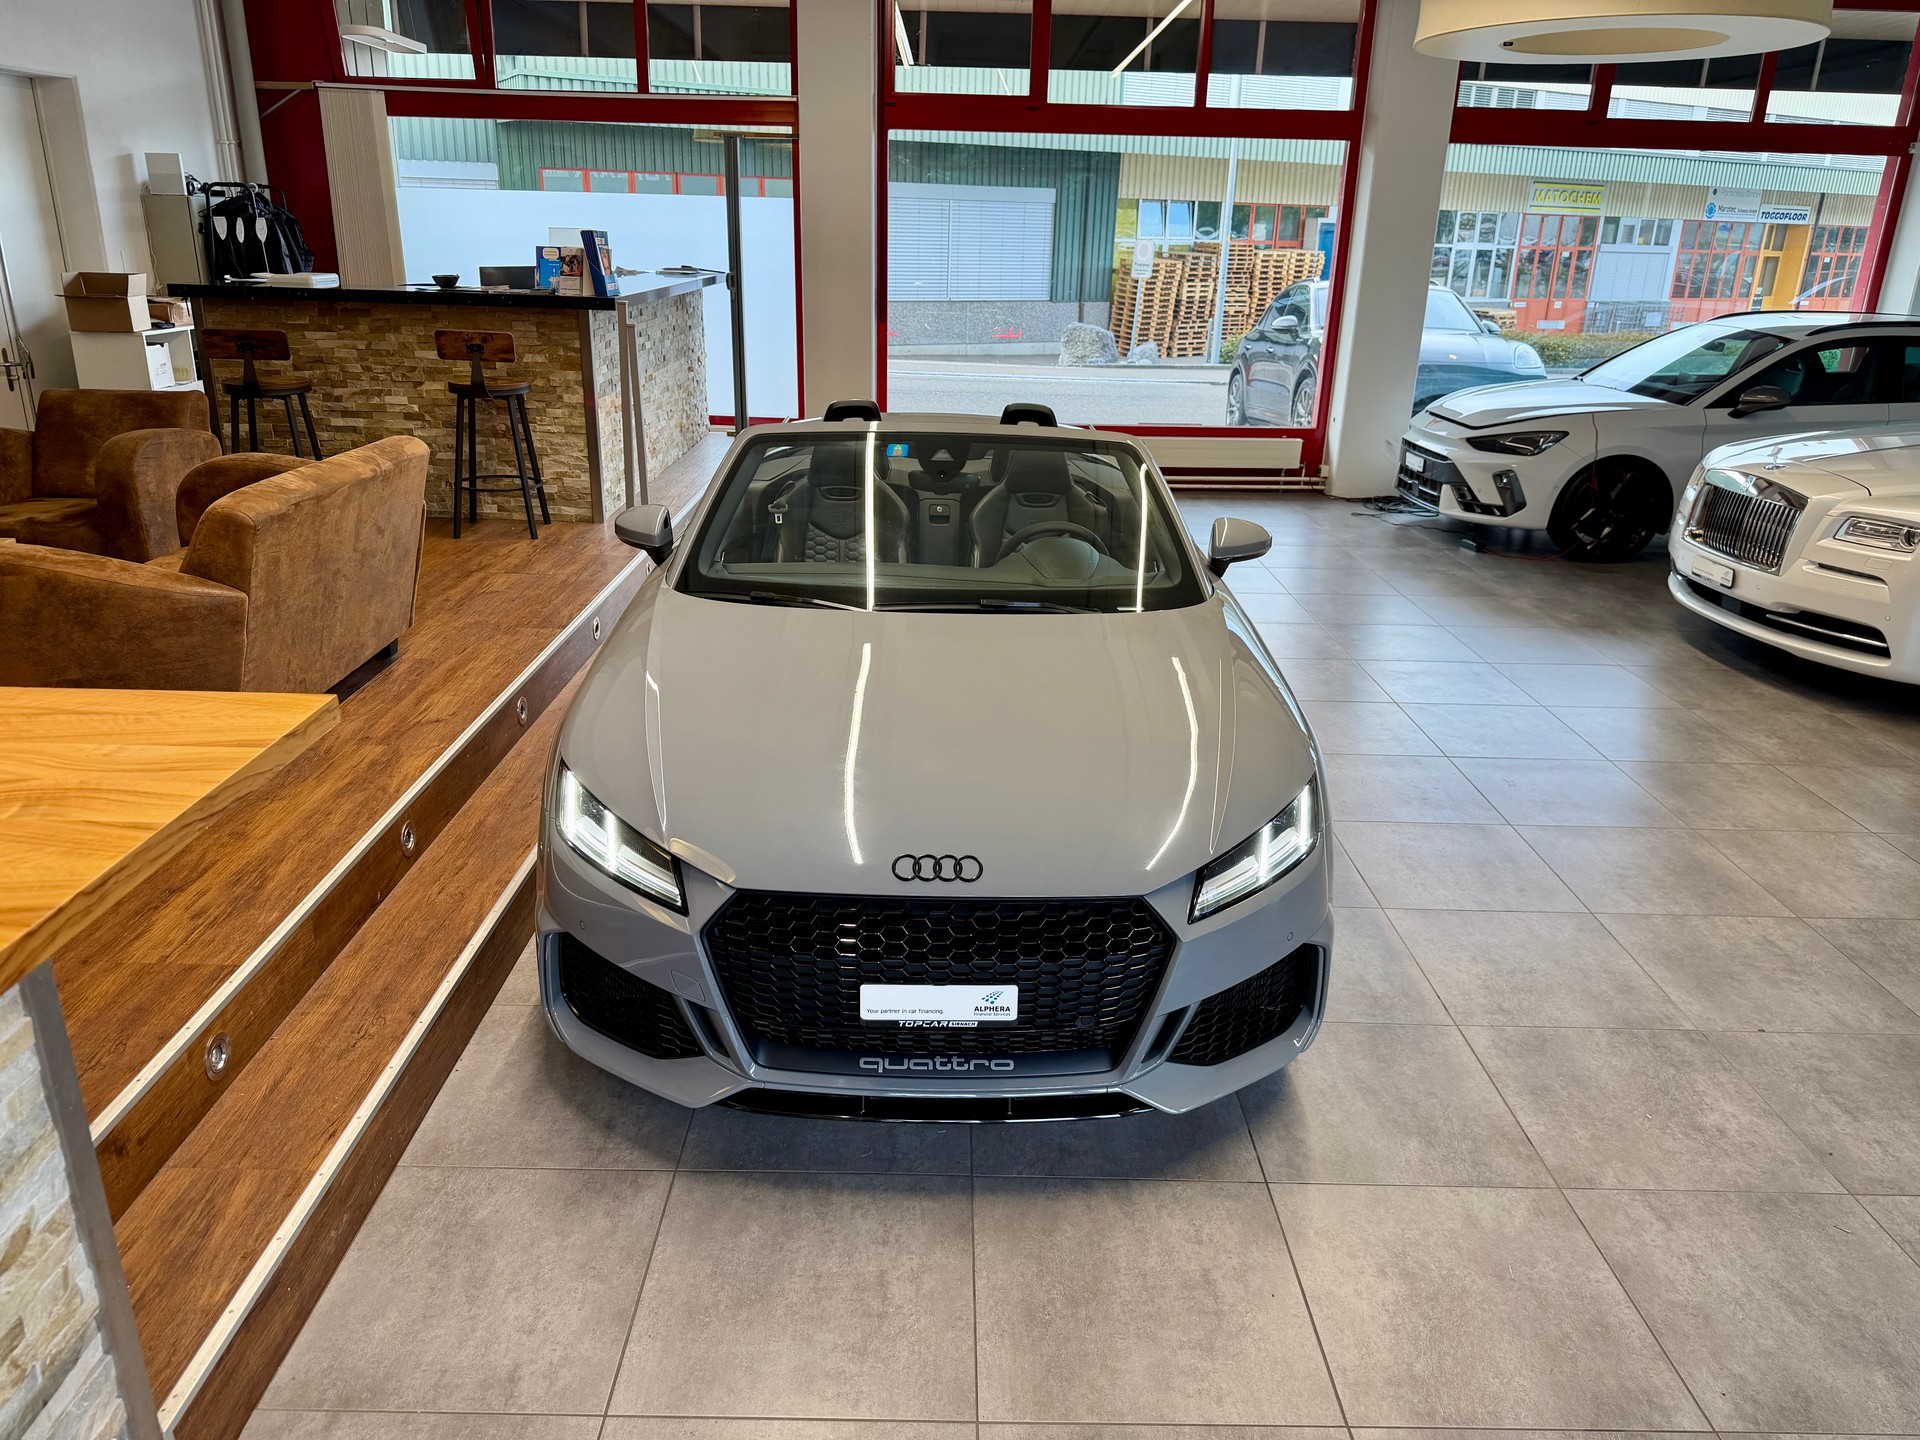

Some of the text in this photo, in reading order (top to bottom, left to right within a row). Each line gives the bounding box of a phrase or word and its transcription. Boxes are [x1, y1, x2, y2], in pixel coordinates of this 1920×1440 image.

[1533, 189, 1602, 206] MATOCHEM
[1760, 211, 1808, 221] TOGGOFLOOR
[898, 1020, 949, 1028] TOPCAR
[859, 1056, 1015, 1073] quattro
